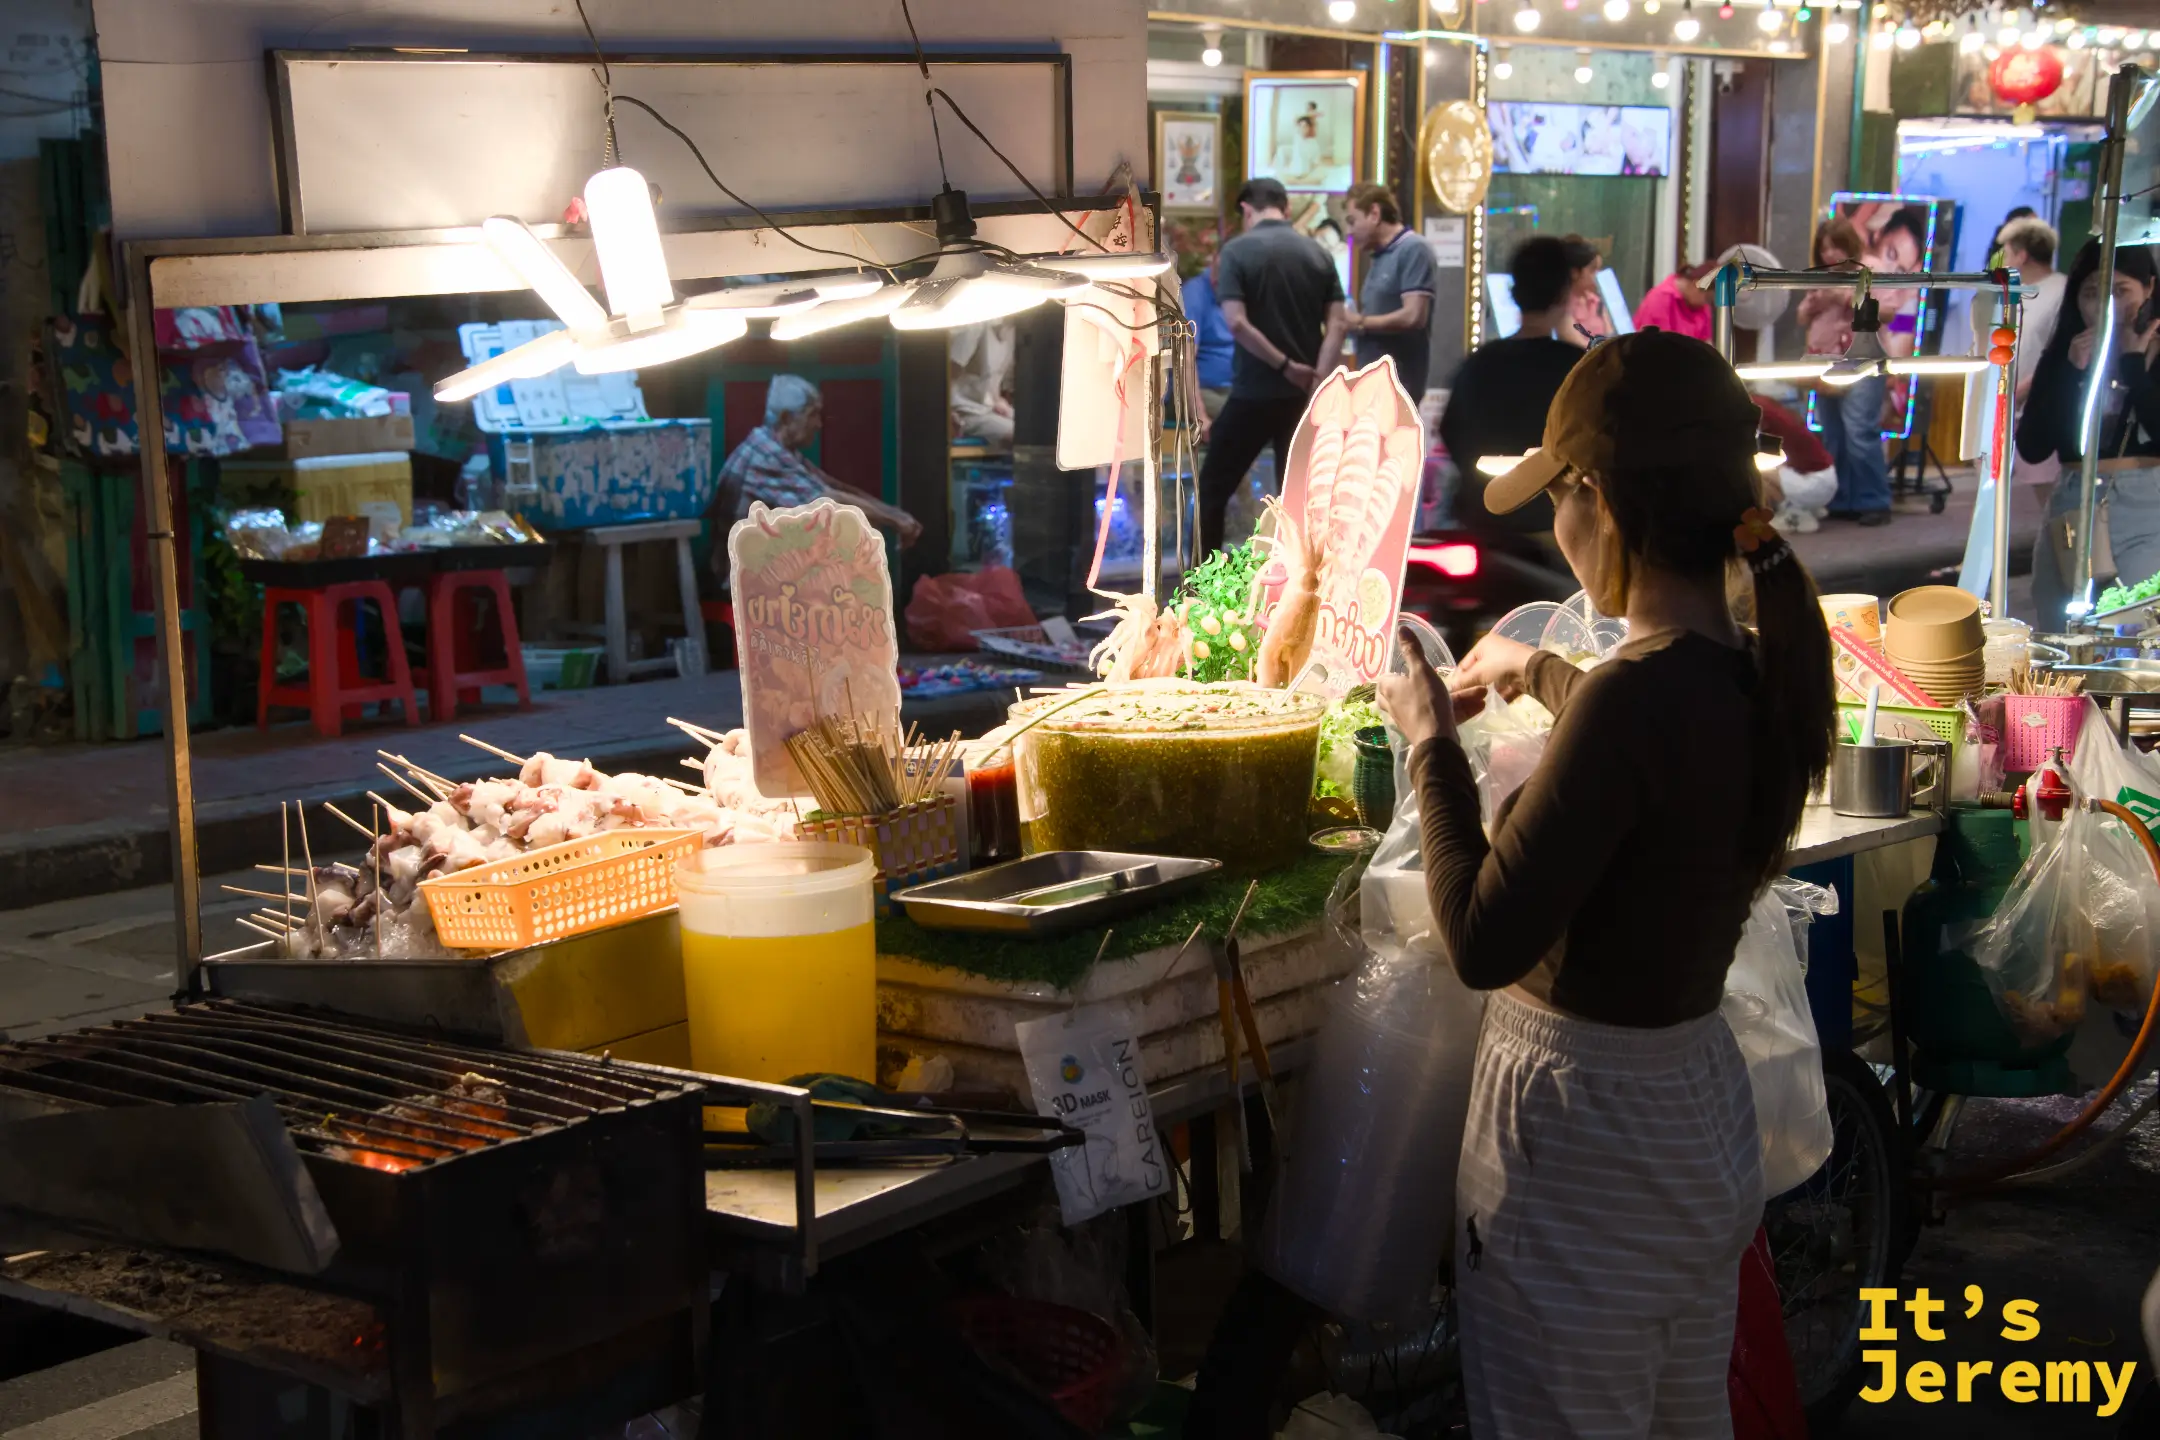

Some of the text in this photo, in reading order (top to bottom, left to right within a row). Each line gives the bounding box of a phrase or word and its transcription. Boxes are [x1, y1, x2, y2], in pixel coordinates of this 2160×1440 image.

[1052, 1089, 1112, 1116] 3D MASK
[1112, 1039, 1163, 1191] CAREION
